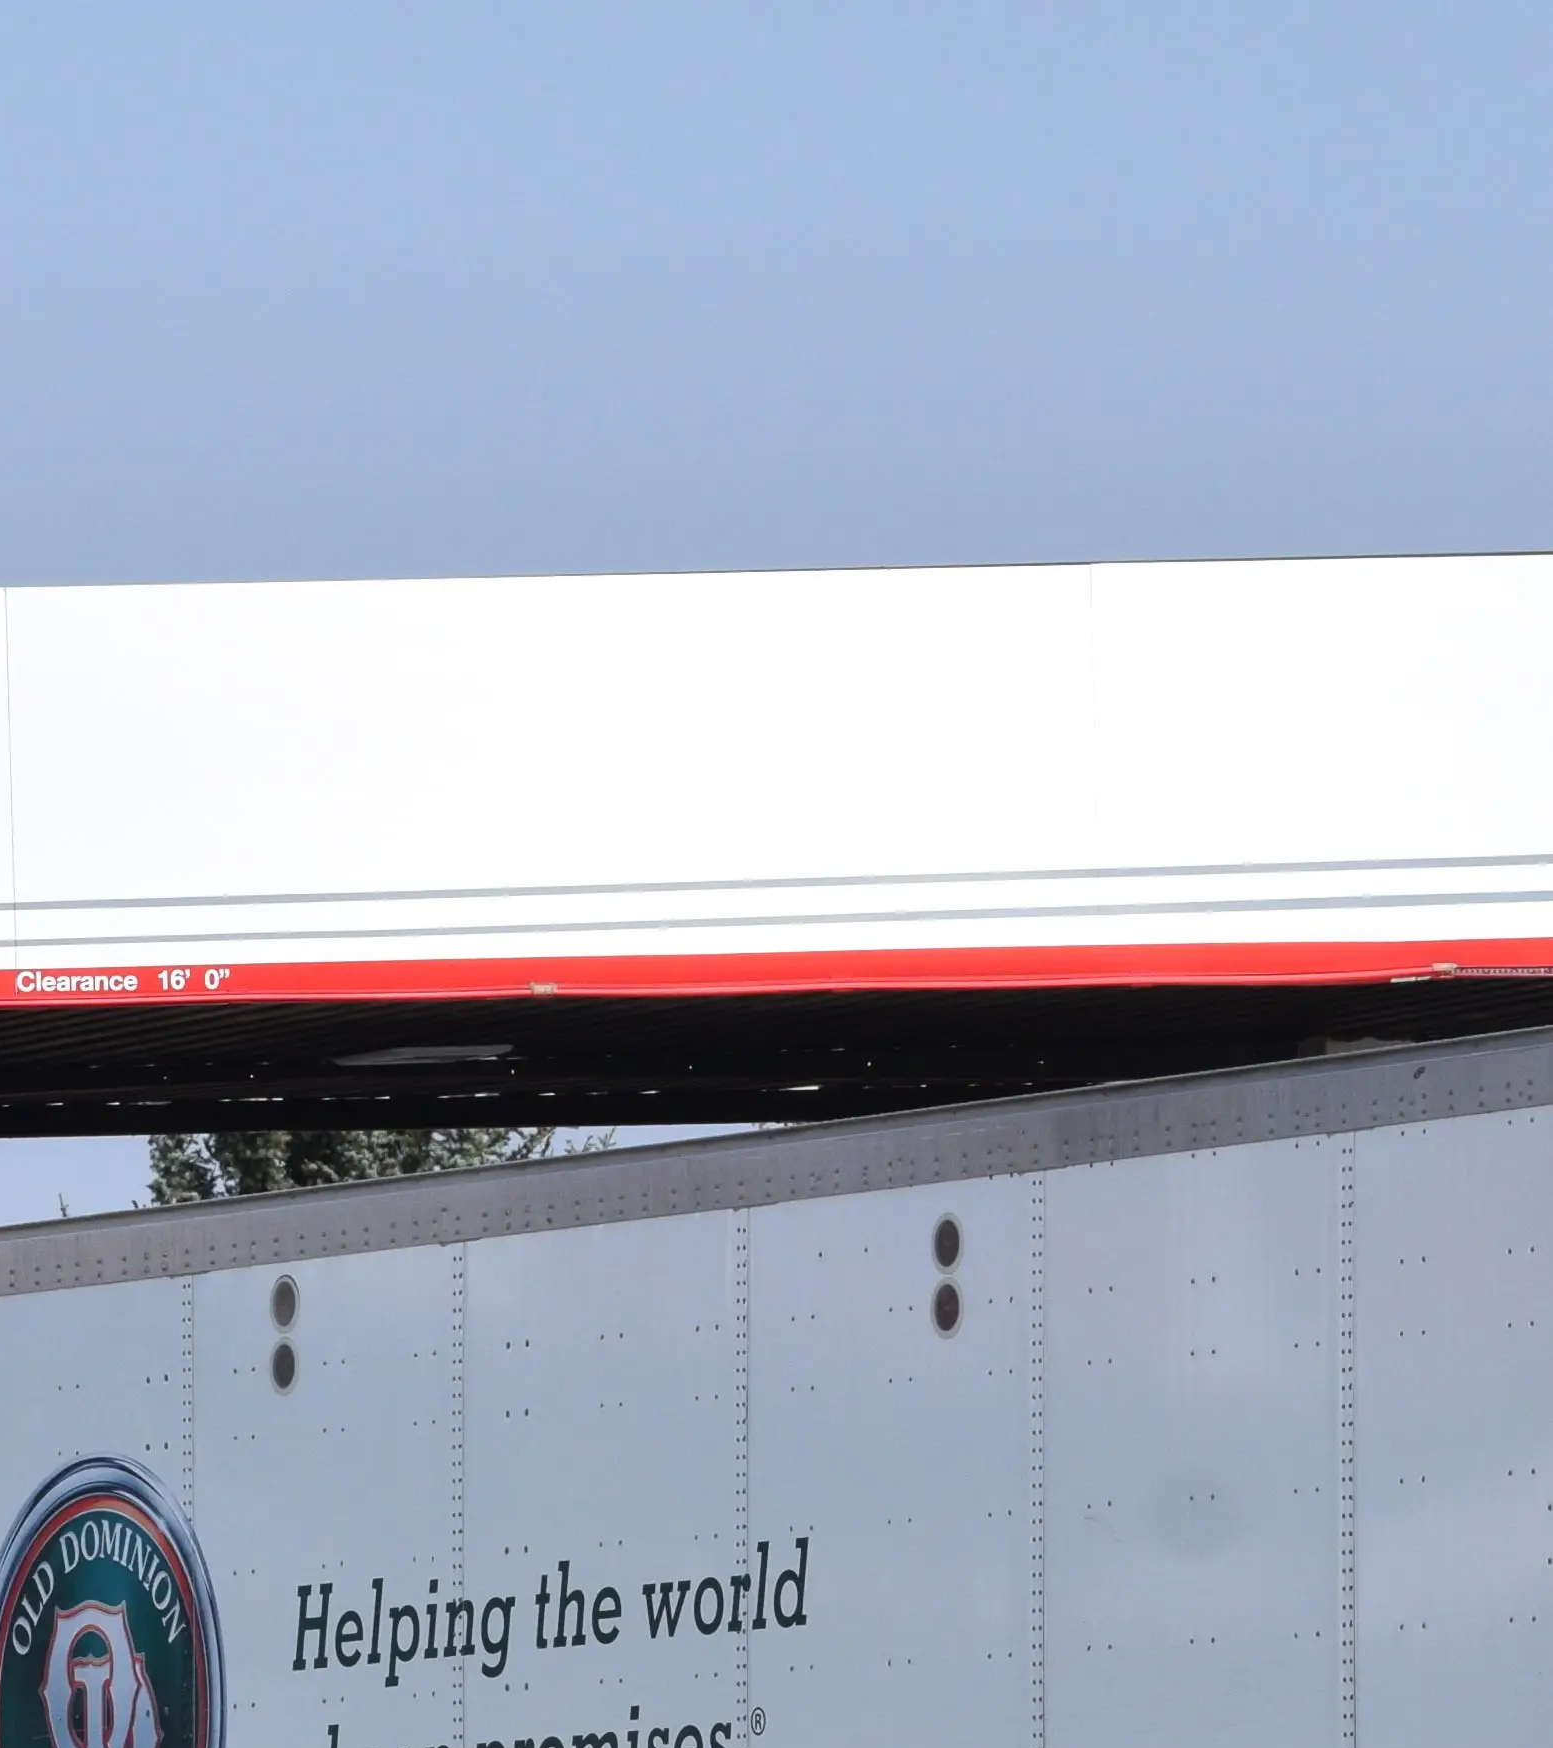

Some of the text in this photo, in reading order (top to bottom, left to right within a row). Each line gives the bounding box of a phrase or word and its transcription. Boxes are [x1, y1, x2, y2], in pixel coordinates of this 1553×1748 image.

[16, 970, 139, 993] Clearance
[12, 1519, 187, 1656] OLD DOMINION
[291, 1536, 810, 1688] Helping the world
